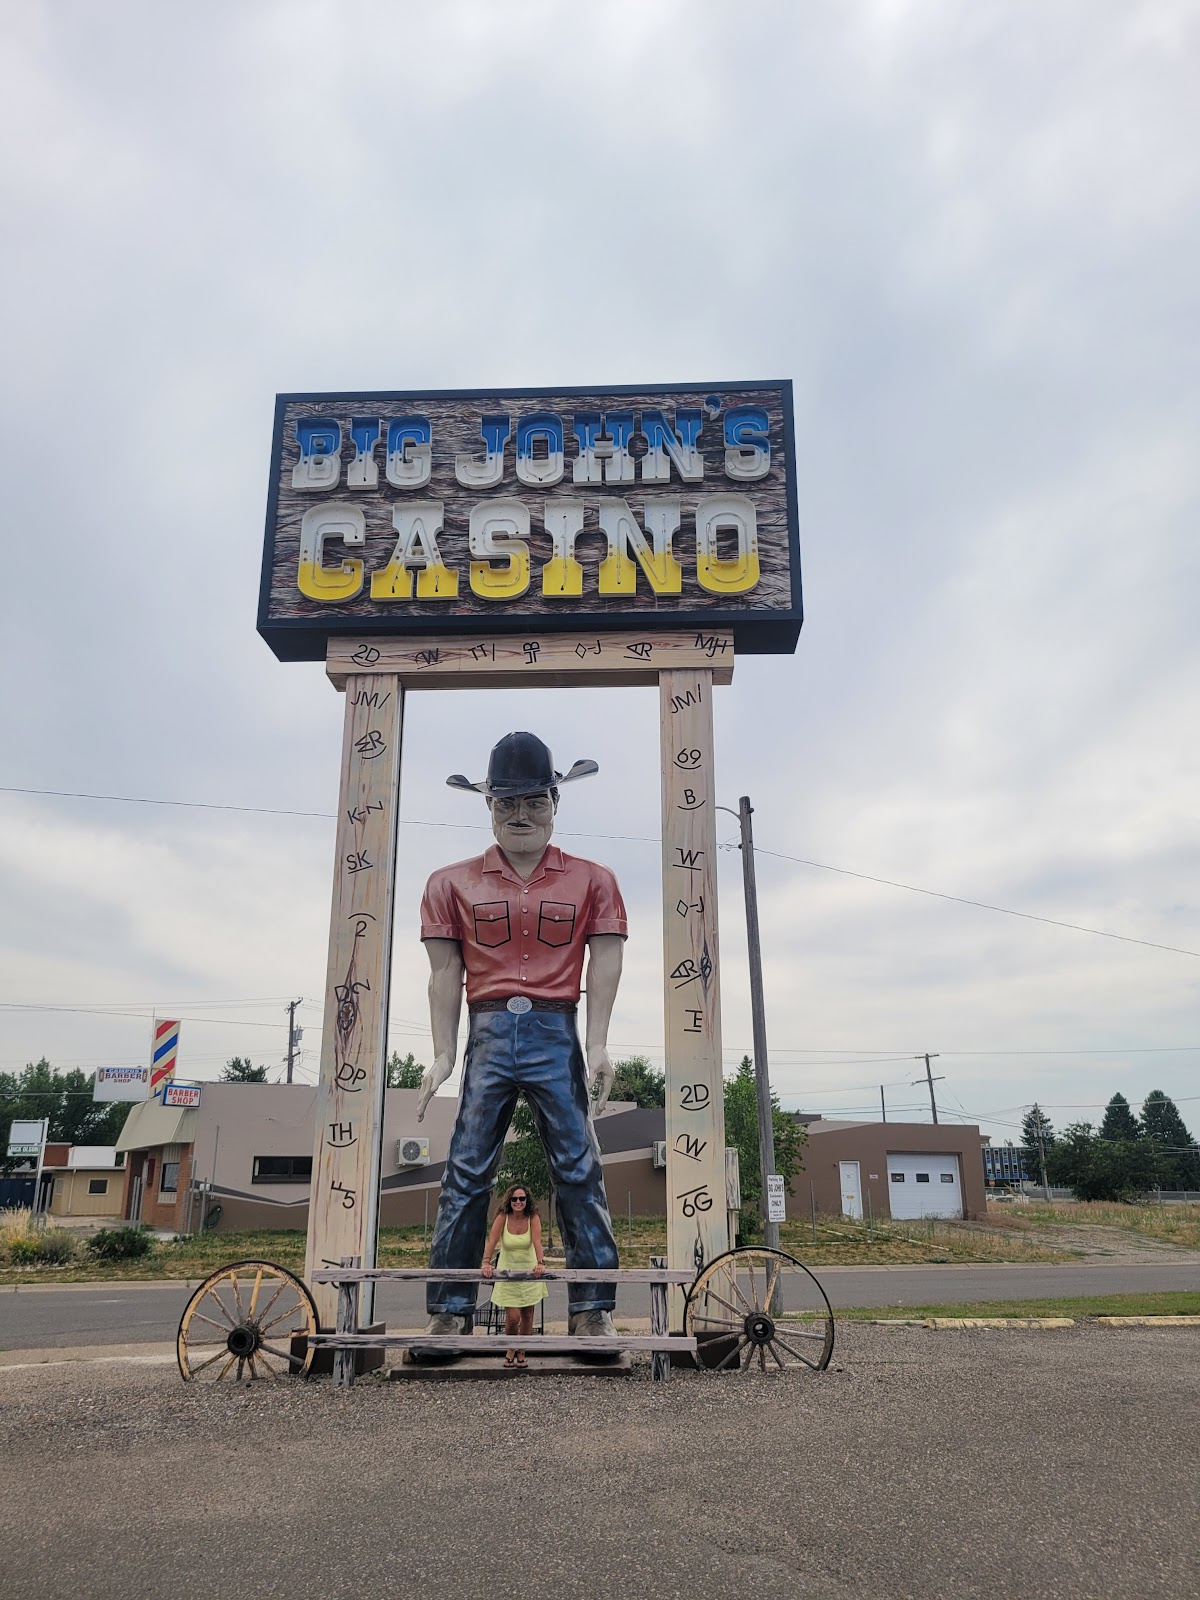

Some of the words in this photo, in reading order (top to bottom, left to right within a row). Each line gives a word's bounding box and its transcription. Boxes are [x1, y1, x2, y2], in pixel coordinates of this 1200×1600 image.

[292, 415, 432, 492] BIG
[455, 395, 771, 490] JOHN'S
[298, 493, 760, 602] CASINO
[677, 748, 702, 765] 69
[684, 788, 697, 805] B
[346, 849, 372, 871] SK
[337, 1062, 366, 1085] DP
[168, 1088, 199, 1098] BARBER
[172, 1096, 194, 1105] SHOP
[680, 1084, 709, 1104] 2D
[329, 1122, 352, 1142] TH
[682, 1191, 713, 1218] 6G
